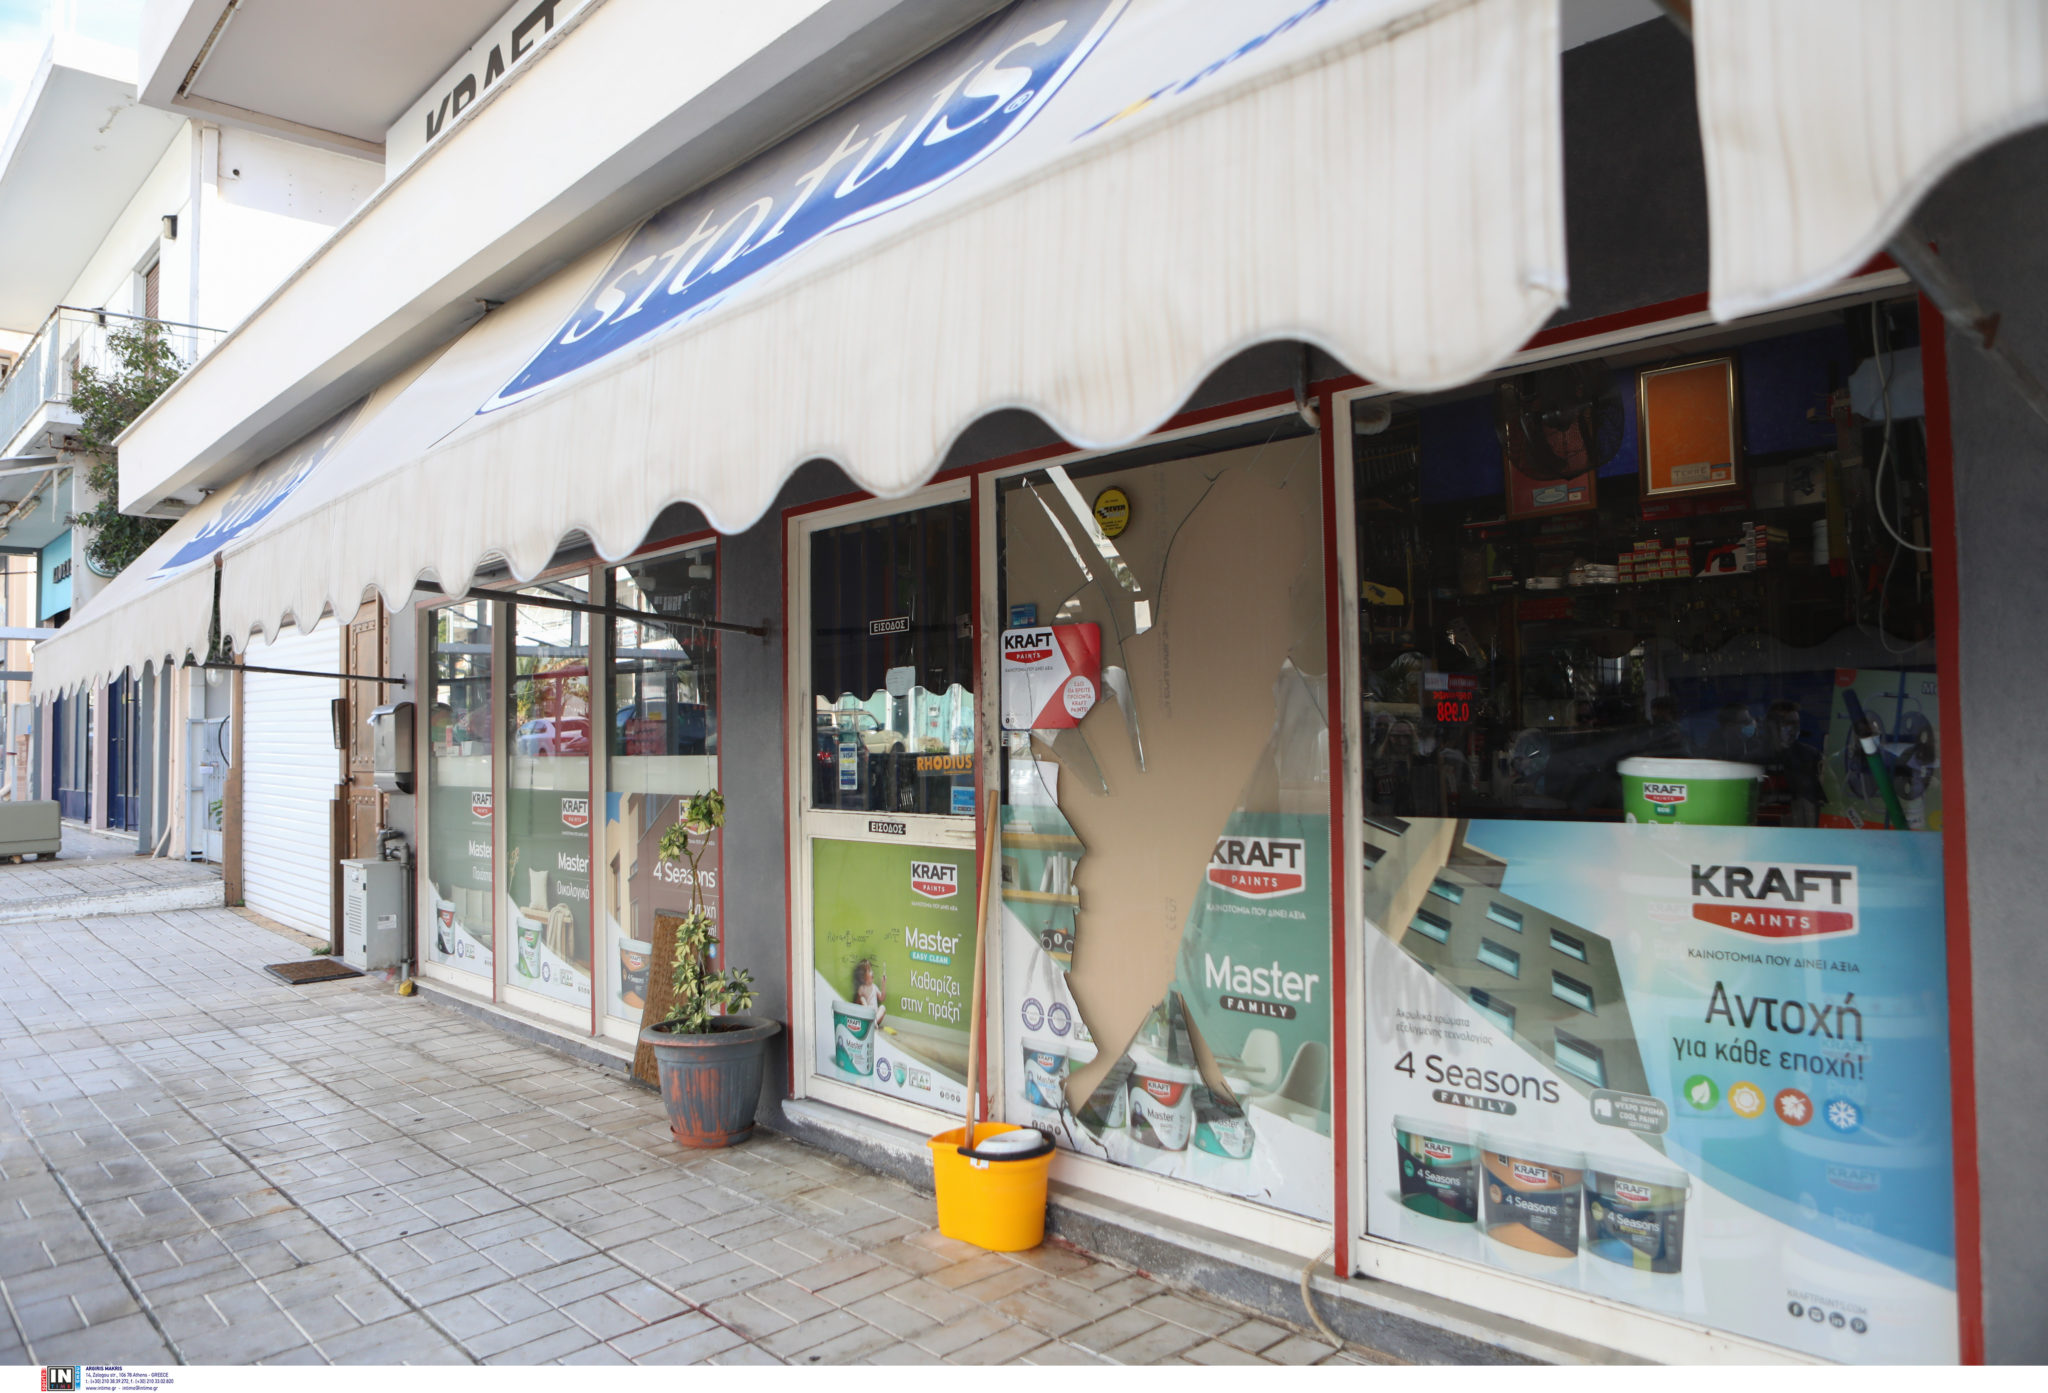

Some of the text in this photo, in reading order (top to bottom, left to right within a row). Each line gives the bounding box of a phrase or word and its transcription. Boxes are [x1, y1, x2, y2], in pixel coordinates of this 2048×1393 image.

[873, 619, 906, 632] ΕΙΣΟΔΟΣ
[1005, 632, 1052, 649] KRAFT
[1016, 652, 1041, 660] PAINTS
[916, 754, 973, 771] RHODIUS
[1644, 784, 1685, 794] KRAFT
[472, 794, 492, 805] KRAFT
[562, 800, 587, 813] KRAFT
[871, 822, 905, 834] ΕΙΣΟΔΟΣ
[558, 851, 589, 873] Master
[1210, 840, 1301, 868] KRAFT
[653, 862, 662, 881] 4
[912, 863, 956, 881] KRAFT
[923, 884, 945, 892] PAINTS
[1232, 874, 1279, 887] PAINTS
[1691, 864, 1852, 905] KRAFT
[1251, 906, 1266, 917] ΠΟΥ
[1730, 911, 1811, 929] PAINTS
[905, 926, 959, 955] Master
[912, 951, 949, 965] EASY CLEAN
[1687, 948, 1861, 973] ΚΑΙΝΟΤΟΜΙΑ ΠΟΥ ΔΙΝΕΙ ΑΞΙΑ
[910, 969, 961, 999] Καθαρίζει
[1205, 952, 1320, 1004] Master
[900, 996, 923, 1013] στην
[1227, 997, 1288, 1017] FAMILY
[1704, 980, 1863, 1042] Αντοχή
[1672, 1036, 1864, 1081] για κάθε εποχή!
[1147, 1081, 1169, 1091] KRAFT
[1394, 1051, 1560, 1104] 4 Seasons
[1440, 1092, 1508, 1113] FAMILY
[1147, 1108, 1175, 1122] Master
[1424, 1141, 1452, 1153] KRAFT
[1417, 1168, 1461, 1186] 4 Seasons
[1514, 1163, 1547, 1178] KRAFT
[1616, 1181, 1650, 1195] KRAFT
[1505, 1194, 1558, 1215] 4 Seasons
[1607, 1211, 1661, 1232] 4 Seasons
